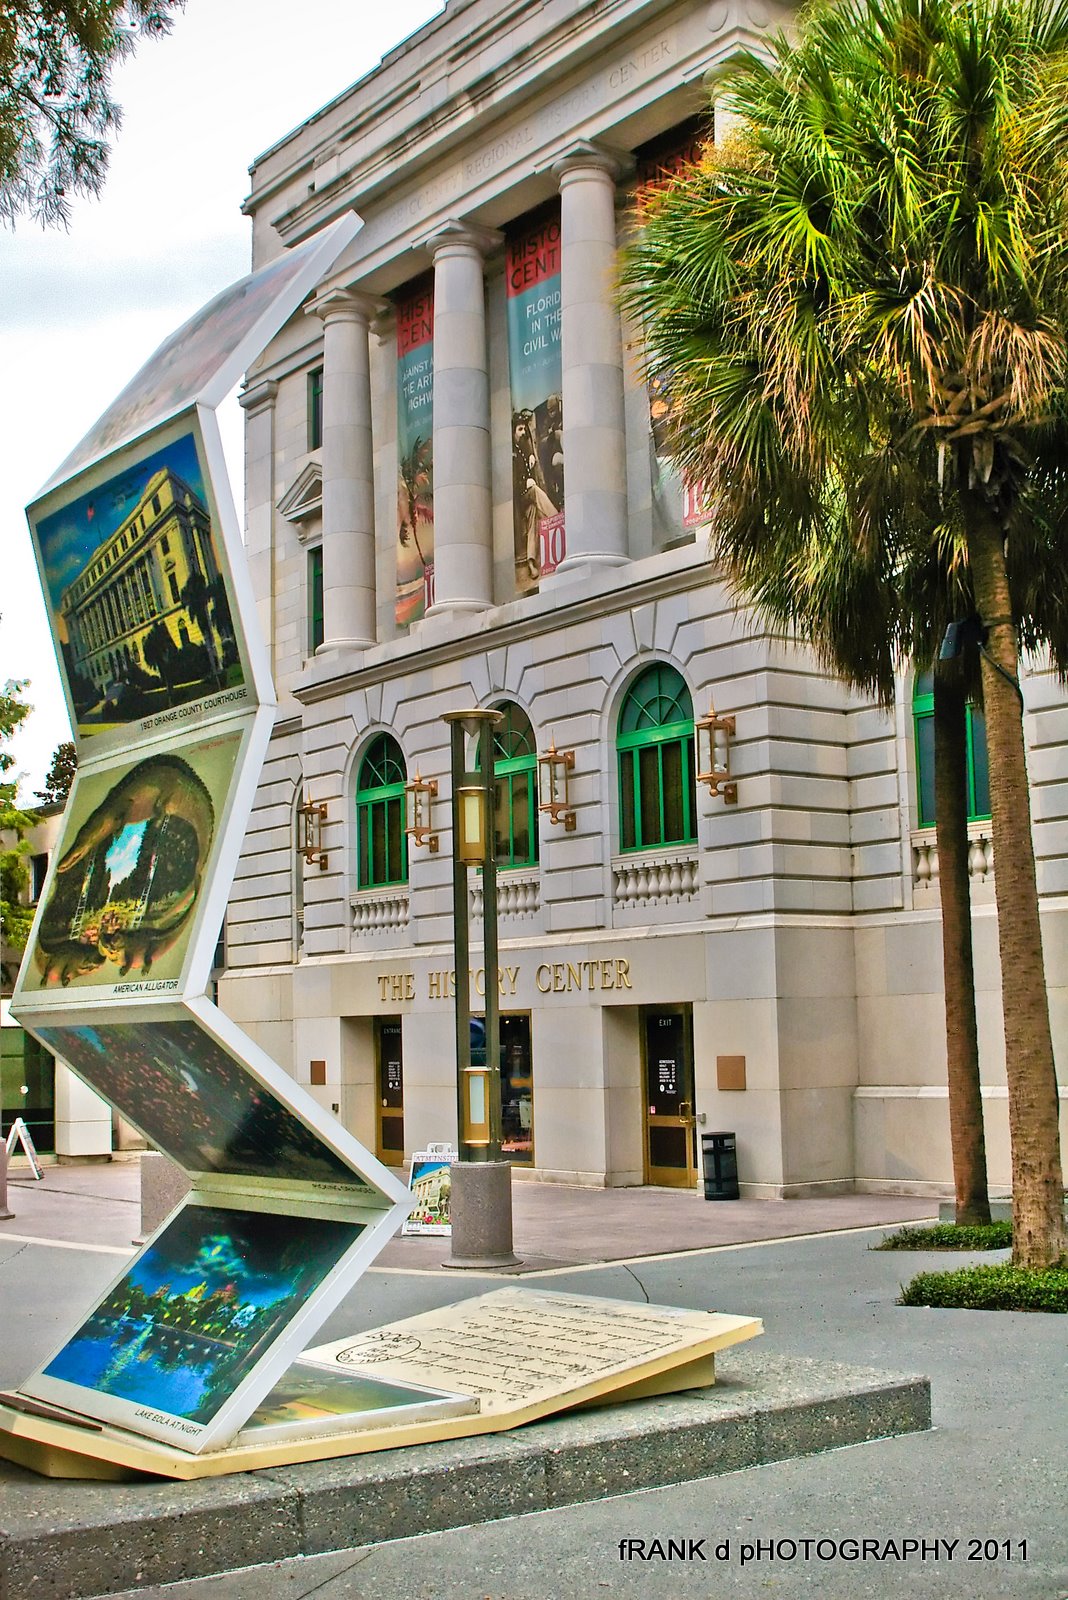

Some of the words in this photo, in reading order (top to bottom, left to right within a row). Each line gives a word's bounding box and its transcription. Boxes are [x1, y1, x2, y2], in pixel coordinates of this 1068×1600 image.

[608, 39, 672, 89] CENTER
[531, 318, 541, 334] IN
[523, 335, 549, 356] CIVIL
[154, 711, 178, 726] ORANGE
[178, 703, 203, 717] COUNTY
[204, 688, 247, 710] COURTHOUSE
[113, 983, 143, 994] AMERICAN
[144, 981, 179, 991] ALLIGATOR
[377, 972, 416, 1002] THE
[535, 958, 633, 993] CENTER
[659, 1018, 672, 1027] EXIT
[134, 1408, 153, 1420] LAKE
[152, 1414, 170, 1425] EOLA
[169, 1420, 181, 1429] AT
[178, 1424, 203, 1437] NIGHT
